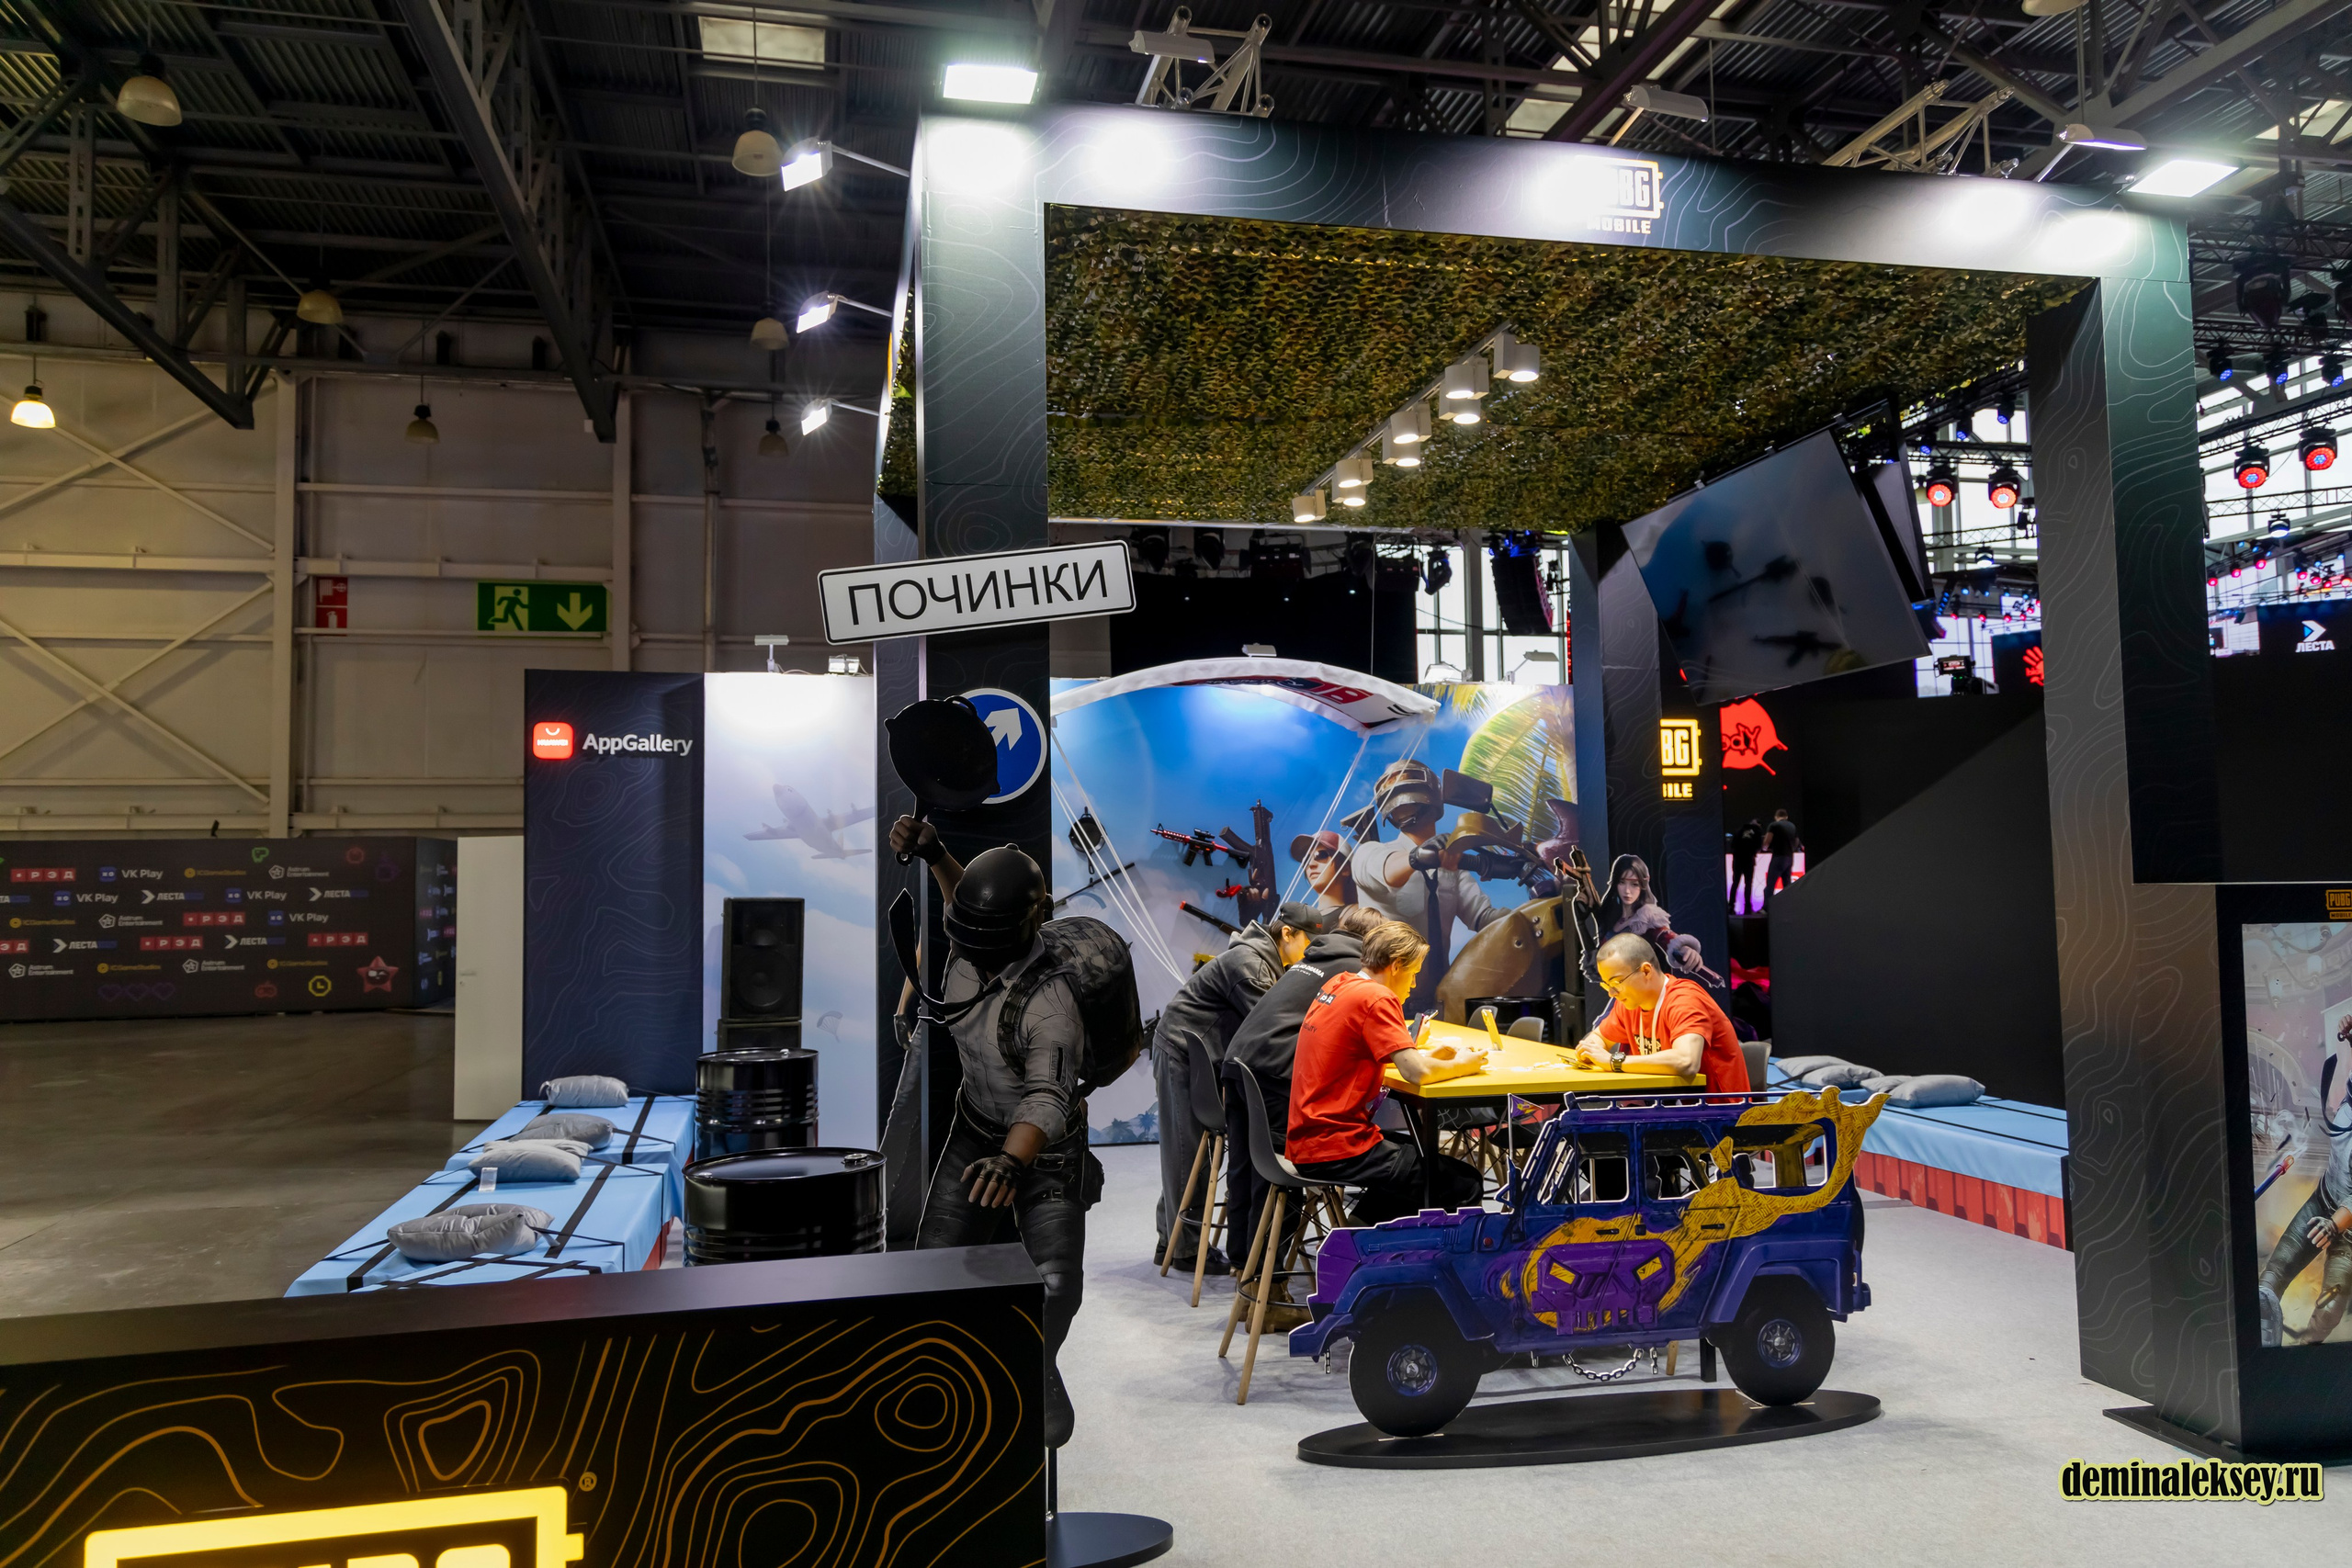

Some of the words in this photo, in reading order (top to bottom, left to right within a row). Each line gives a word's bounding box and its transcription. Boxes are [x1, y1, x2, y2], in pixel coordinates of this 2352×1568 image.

[848, 558, 1108, 626] ПОЧИНКИ
[2295, 640, 2335, 652] ЛЕСТА
[582, 733, 693, 757] AppGallery
[1660, 728, 1690, 766] BG
[1662, 783, 1693, 798] ILE
[121, 869, 138, 878] VK
[140, 869, 164, 880] Play
[76, 894, 93, 903] VK
[95, 893, 119, 904] Play
[156, 892, 186, 901] ЛЕСТА
[246, 890, 263, 899] VK
[265, 890, 288, 901] Play
[323, 889, 351, 898] ЛЕСТА
[2329, 893, 2351, 907] PUBG
[288, 913, 305, 922] VK
[307, 913, 329, 923] Play
[69, 941, 98, 949] ЛЕСТА
[239, 937, 267, 945] ЛЕСТА
